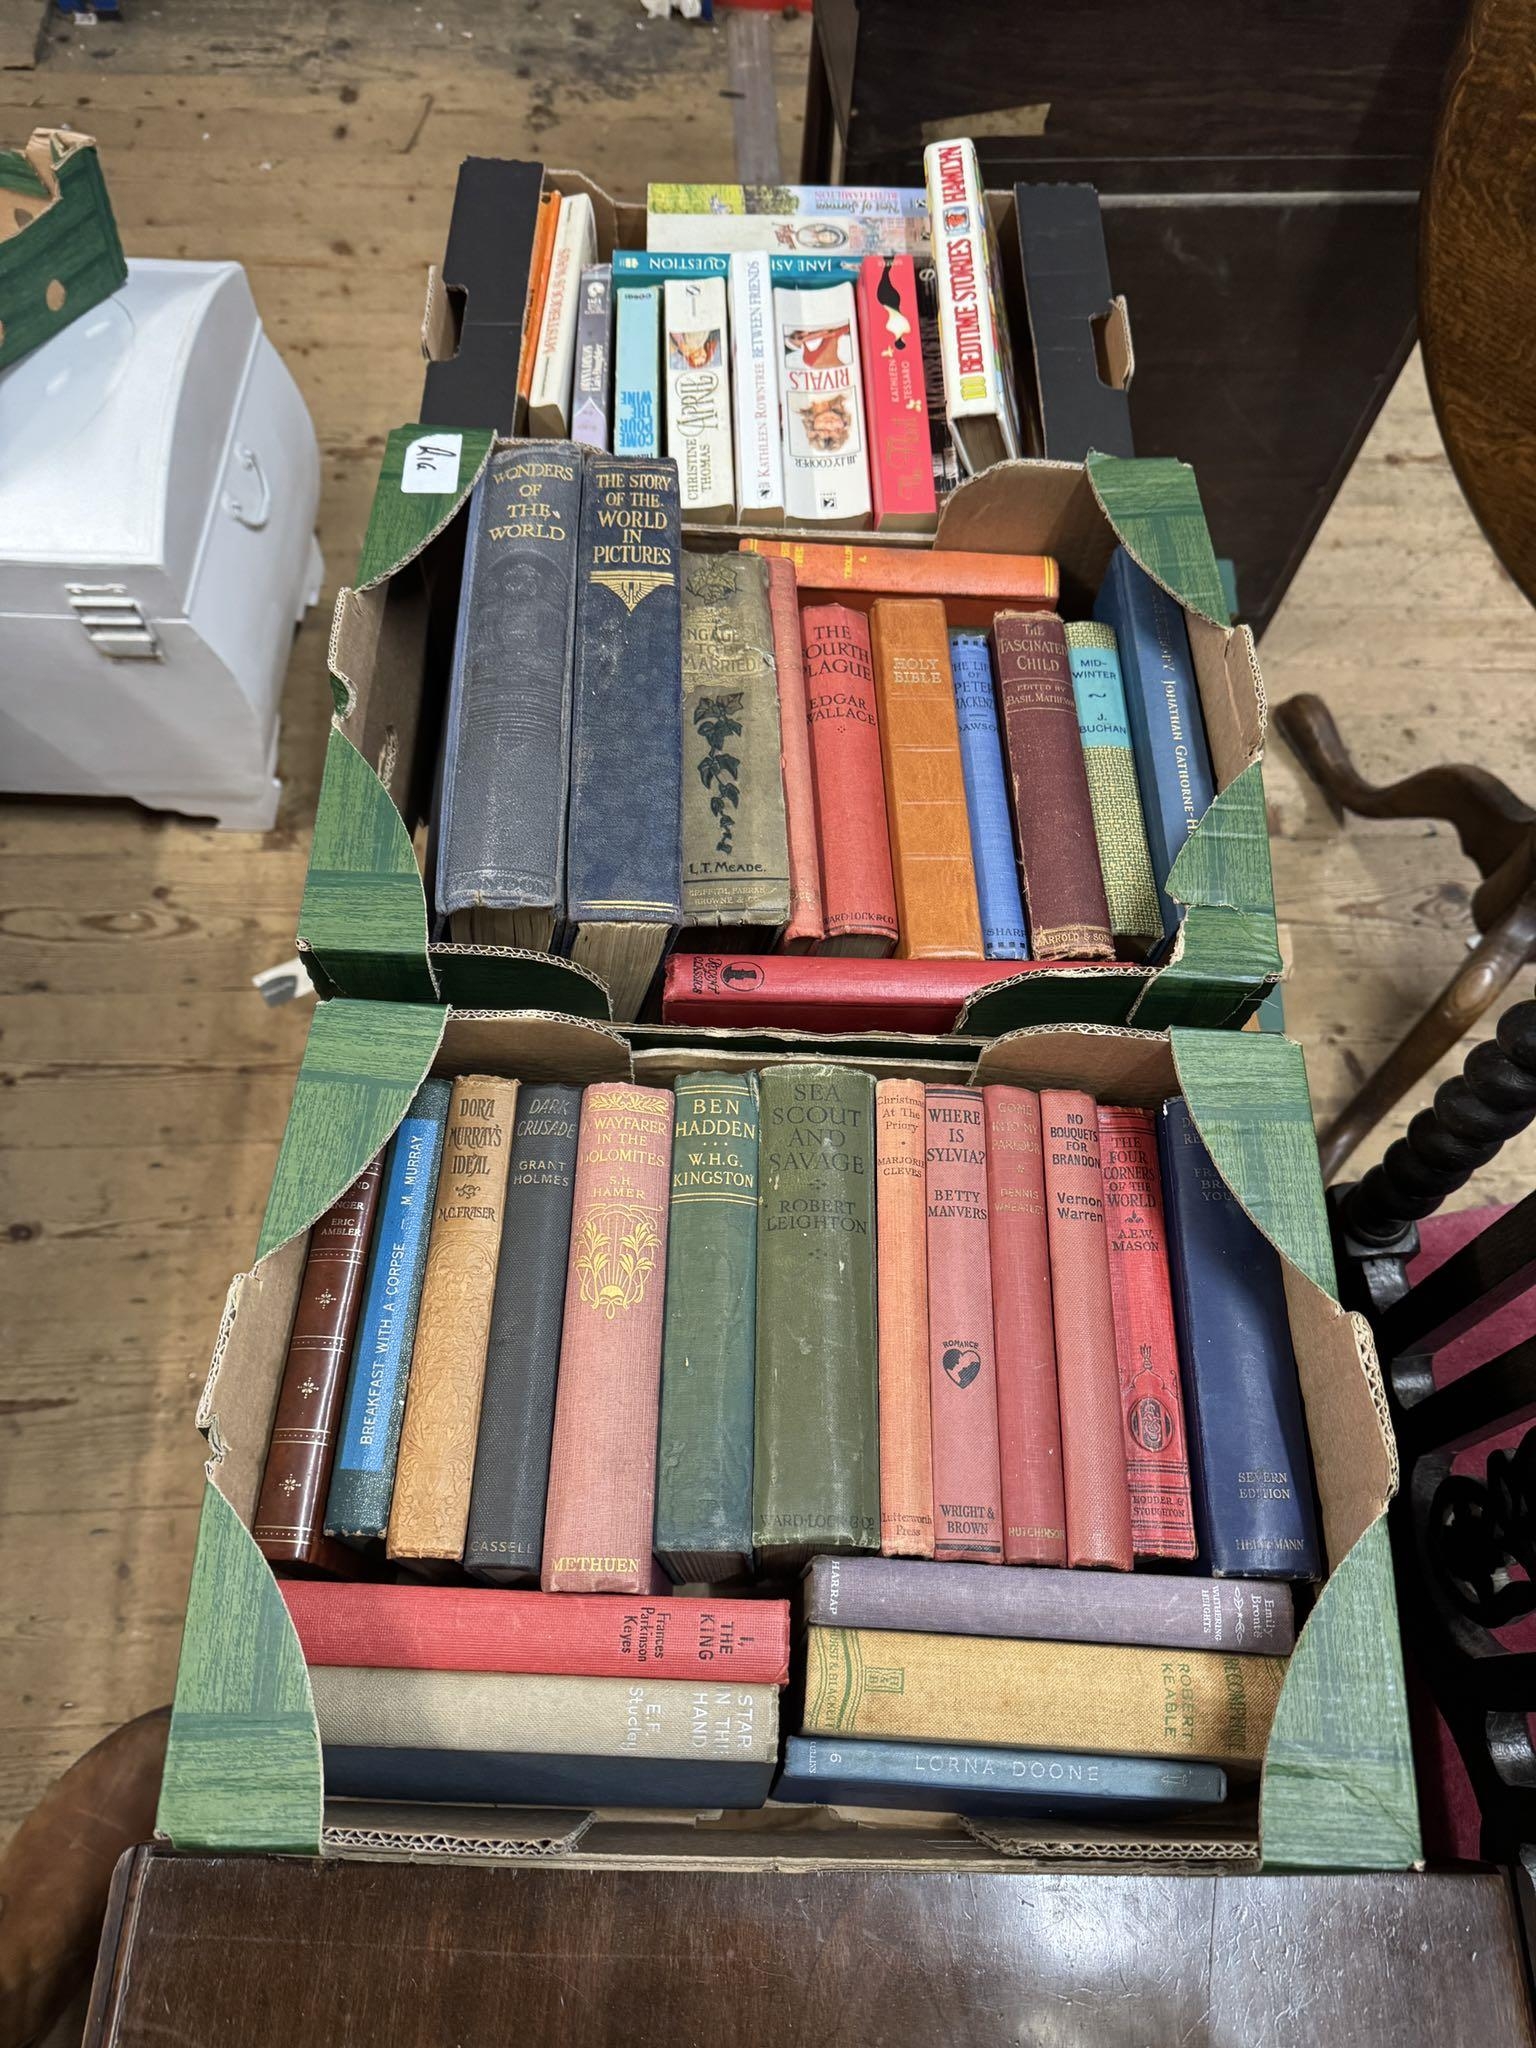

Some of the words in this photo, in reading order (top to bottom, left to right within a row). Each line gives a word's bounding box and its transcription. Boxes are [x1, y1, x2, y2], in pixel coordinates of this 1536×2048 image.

[939, 145, 966, 204] HAMLYN
[649, 257, 726, 271] QUESTION
[797, 260, 832, 272] JANE
[947, 239, 977, 303] STORIES
[748, 260, 762, 308] FRIENDS
[750, 310, 765, 358] BETWEEN
[954, 303, 984, 375] BEDTIME
[789, 368, 850, 390] RIVALS
[903, 362, 911, 400] TESSARO
[620, 390, 653, 405] WINE
[755, 364, 768, 419] ROWNTREE
[632, 405, 653, 419] THE
[619, 419, 654, 433] POUR
[619, 433, 654, 448] COME
[758, 423, 770, 478] KATHLEEN
[701, 444, 711, 493] THOMAS
[794, 455, 832, 467] COOPER
[492, 463, 574, 485] WONDERS
[687, 439, 699, 500] CHRISTINE
[519, 484, 541, 497] OF
[596, 474, 625, 489] THE
[629, 474, 672, 491] STORY
[605, 492, 625, 507] OF
[507, 504, 552, 519] THE
[597, 511, 668, 530] WORLD
[489, 524, 566, 541] WORLD
[623, 530, 642, 544] IN
[593, 545, 671, 566] PICTURES
[813, 625, 852, 640] THE
[1022, 624, 1045, 636] THE
[682, 653, 757, 673] MARRIED
[893, 657, 940, 670] HOLY
[1016, 655, 1060, 671] CHILD
[1080, 659, 1108, 667] MID-
[893, 671, 943, 684] BIBLE
[967, 671, 980, 679] OF
[1072, 671, 1117, 680] WINTER
[1016, 683, 1052, 692] EDITED
[809, 693, 867, 711] EDGAR
[1006, 694, 1035, 705] BASIL
[807, 706, 877, 726] WALLACE
[1096, 713, 1108, 721] J.
[1163, 680, 1182, 740] JONATHAN
[1079, 724, 1127, 734] BUCHAN
[692, 955, 704, 995] CLASSICS
[794, 1083, 843, 1102] SEA
[459, 1098, 496, 1120] DORA
[528, 1098, 570, 1116] DARK
[693, 1099, 740, 1115] BEN
[882, 1108, 895, 1119] At
[900, 1108, 921, 1120] The
[998, 1102, 1033, 1116] COME
[772, 1105, 862, 1128] SCOUT
[928, 1108, 981, 1126] WHERE
[1067, 1113, 1084, 1125] NO
[516, 1119, 577, 1139] CRUSADE
[594, 1116, 667, 1135] WAYFARER
[675, 1119, 756, 1140] HADDEN
[885, 1121, 919, 1134] Priory
[1023, 1123, 1038, 1135] MY
[447, 1125, 502, 1150] MURRAY'S
[597, 1133, 612, 1145] IN
[618, 1133, 648, 1146] THE
[788, 1128, 846, 1147] AND
[949, 1128, 965, 1142] IS
[1050, 1126, 1098, 1142] BOUQUETS
[991, 1139, 1041, 1155] PARLOUR
[1066, 1142, 1088, 1153] FOR
[1111, 1136, 1143, 1149] THE
[404, 1135, 424, 1187] MURRAY
[769, 1152, 864, 1174] SAVAGE
[877, 1156, 926, 1169] MARJORIE
[926, 1147, 986, 1165] SYLVIA?
[1052, 1154, 1101, 1169] BRANDON
[1109, 1150, 1147, 1164] FOUR
[450, 1154, 491, 1177] IDEAL
[518, 1160, 567, 1172] GRANT
[883, 1167, 922, 1178] CLEVES
[1103, 1166, 1156, 1180] CORNERS
[513, 1173, 570, 1187] HOLMES
[673, 1171, 755, 1188] KINGSTON
[1108, 1181, 1127, 1191] OF
[1129, 1181, 1152, 1191] THE
[593, 1187, 646, 1201] HAMER
[934, 1189, 981, 1203] BETTY
[1000, 1188, 1039, 1200] DENNIS
[1057, 1192, 1103, 1208] Vernon
[1105, 1193, 1156, 1208] WORLD
[779, 1198, 857, 1215] ROBERT
[928, 1205, 987, 1220] MANVERS
[331, 1218, 355, 1227] ERIC
[1057, 1208, 1103, 1223] Warren
[321, 1228, 362, 1237] AMBLER
[766, 1214, 868, 1235] LEIGHTON
[1112, 1240, 1159, 1253] MASON
[385, 1242, 406, 1296] CORPSE
[386, 1301, 395, 1312] A
[375, 1319, 392, 1354] WITH
[943, 1339, 980, 1350] ROMANCE
[359, 1360, 385, 1445] BREAKFAST
[1238, 1471, 1288, 1484] SEVERN
[1132, 1495, 1173, 1505] HODDER
[1239, 1487, 1291, 1499] EDITION
[881, 1511, 932, 1525] Lutterworth
[940, 1504, 986, 1519] WRIGHT
[987, 1507, 996, 1521] &
[1133, 1506, 1185, 1518] STOUGHTON
[896, 1524, 922, 1537] Press
[947, 1521, 989, 1535] BROWN
[1007, 1526, 1066, 1540] HUTCHINSON
[471, 1541, 536, 1554] CASSELL
[551, 1557, 641, 1573] METHUEN
[829, 1560, 841, 1616] HARRAP
[1201, 1588, 1212, 1634] HEIGHTS
[1211, 1584, 1223, 1643] WUTHERING
[1263, 1598, 1275, 1639] Emily
[619, 1615, 638, 1654] Keyes
[637, 1607, 656, 1663] Parkinson
[654, 1612, 671, 1660] Frances
[698, 1613, 715, 1661] KING
[719, 1621, 734, 1655] THE
[828, 1662, 838, 1672] &
[714, 1686, 732, 1705] IN
[824, 1672, 840, 1731] BLACKETT
[1161, 1662, 1178, 1738] KEABLE
[1178, 1662, 1194, 1742] ROBERT
[619, 1687, 644, 1752] Stucley
[691, 1692, 709, 1749] HAND
[736, 1693, 754, 1749] STAR
[914, 1754, 996, 1775] LORNA
[1012, 1760, 1099, 1781] DOONE
